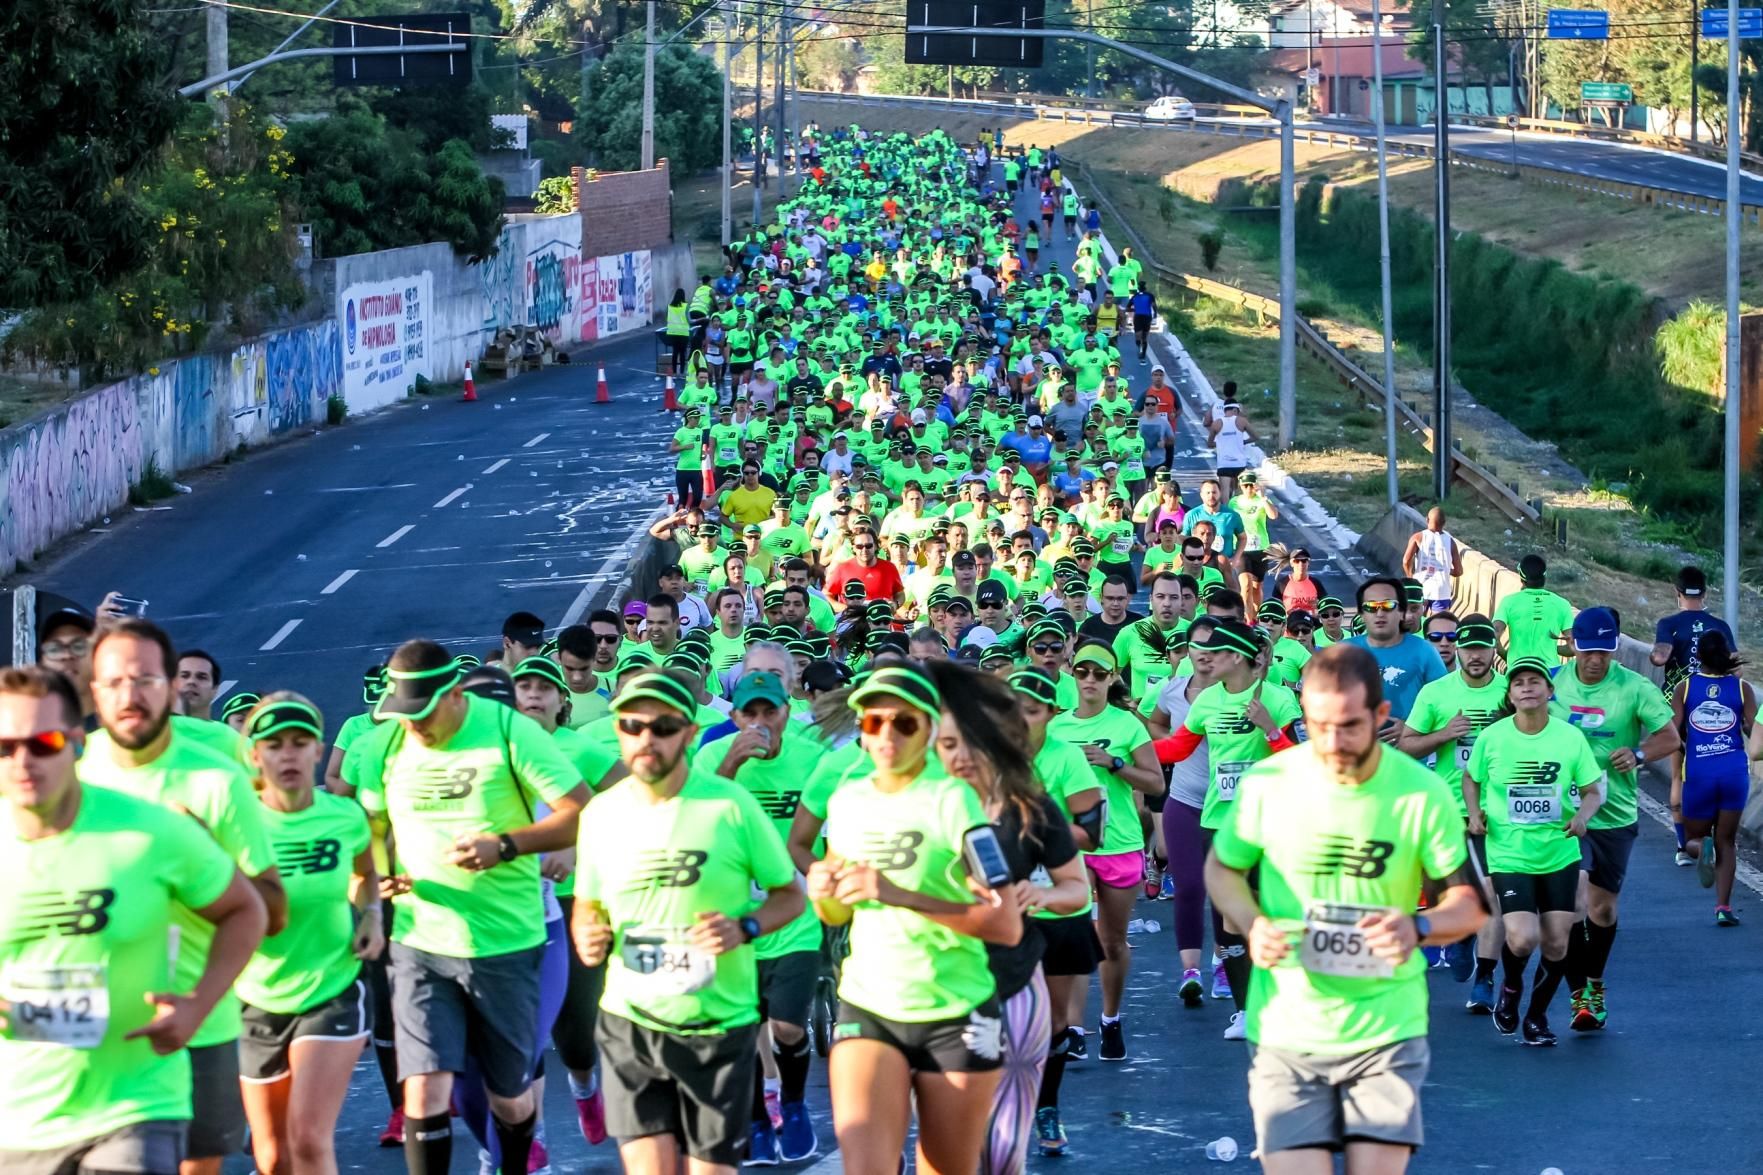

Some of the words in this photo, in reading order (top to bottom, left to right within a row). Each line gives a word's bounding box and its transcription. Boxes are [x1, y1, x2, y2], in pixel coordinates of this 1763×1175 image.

[1221, 775, 1241, 790] 00
[1514, 800, 1550, 813] 0068
[1312, 930, 1374, 956] 065
[634, 951, 691, 974] 1184
[19, 996, 94, 1024] 0412
